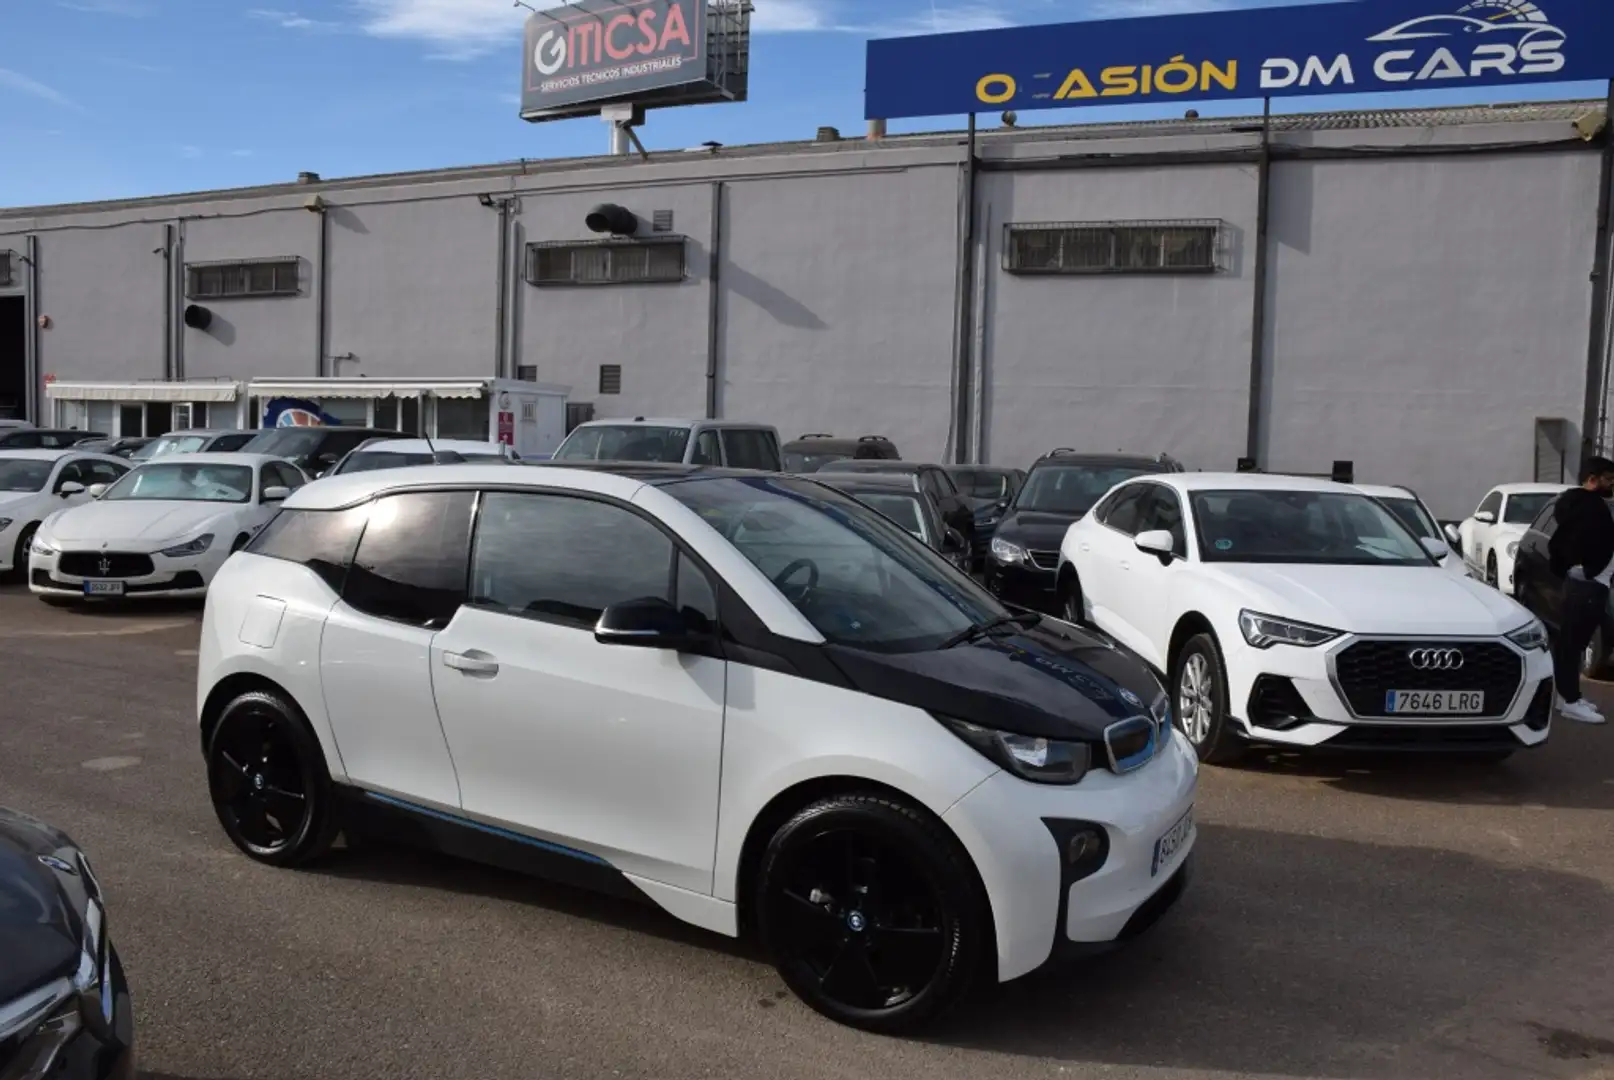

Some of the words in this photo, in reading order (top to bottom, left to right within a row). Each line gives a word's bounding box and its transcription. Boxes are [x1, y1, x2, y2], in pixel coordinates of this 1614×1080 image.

[621, 56, 682, 77] INDUSTRIALES
[975, 54, 1237, 103] OASIÓN
[1260, 53, 1354, 88] DM
[1373, 40, 1565, 81] CARS
[1399, 692, 1443, 710] 7646
[1448, 692, 1480, 710] LRG
